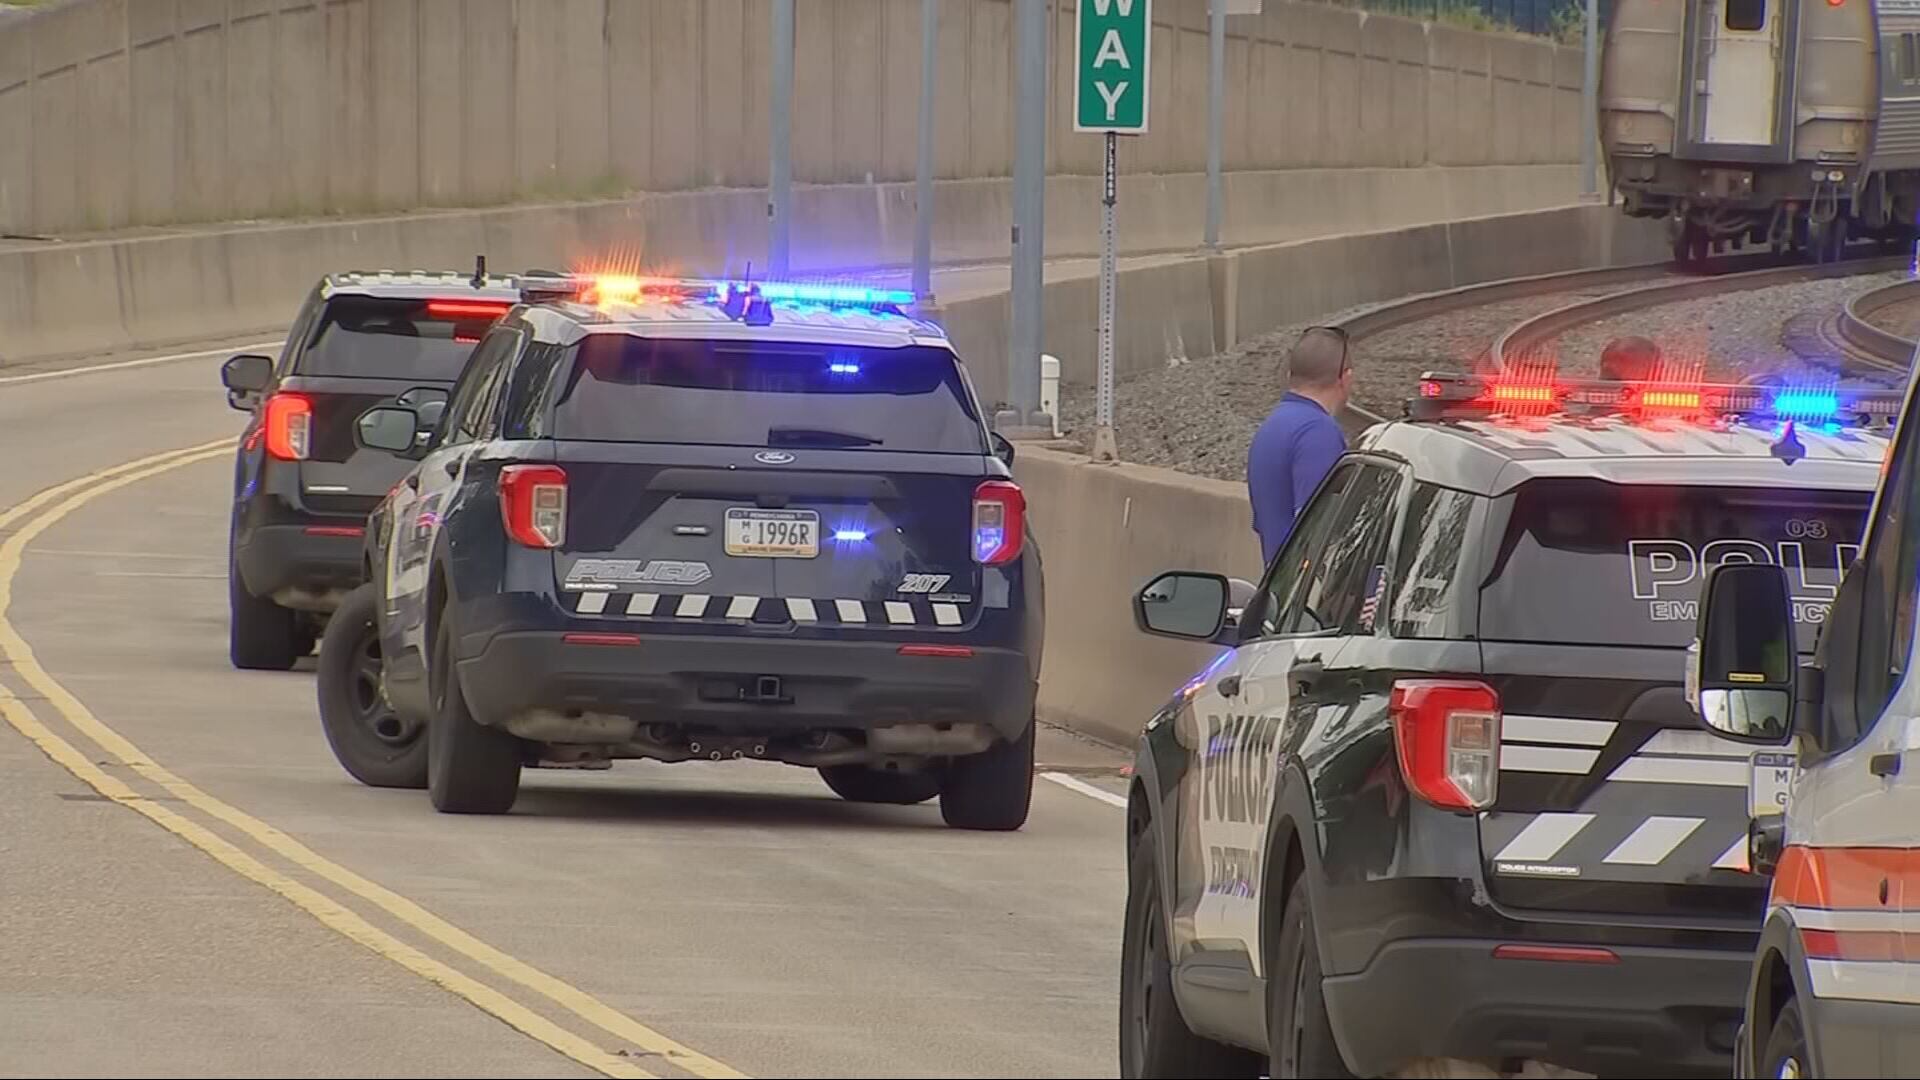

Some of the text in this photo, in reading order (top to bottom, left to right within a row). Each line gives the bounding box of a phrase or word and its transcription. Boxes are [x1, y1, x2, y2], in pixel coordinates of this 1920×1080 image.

[758, 521, 810, 545] 1996R
[1785, 519, 1828, 539] 03
[897, 573, 951, 593] 207
